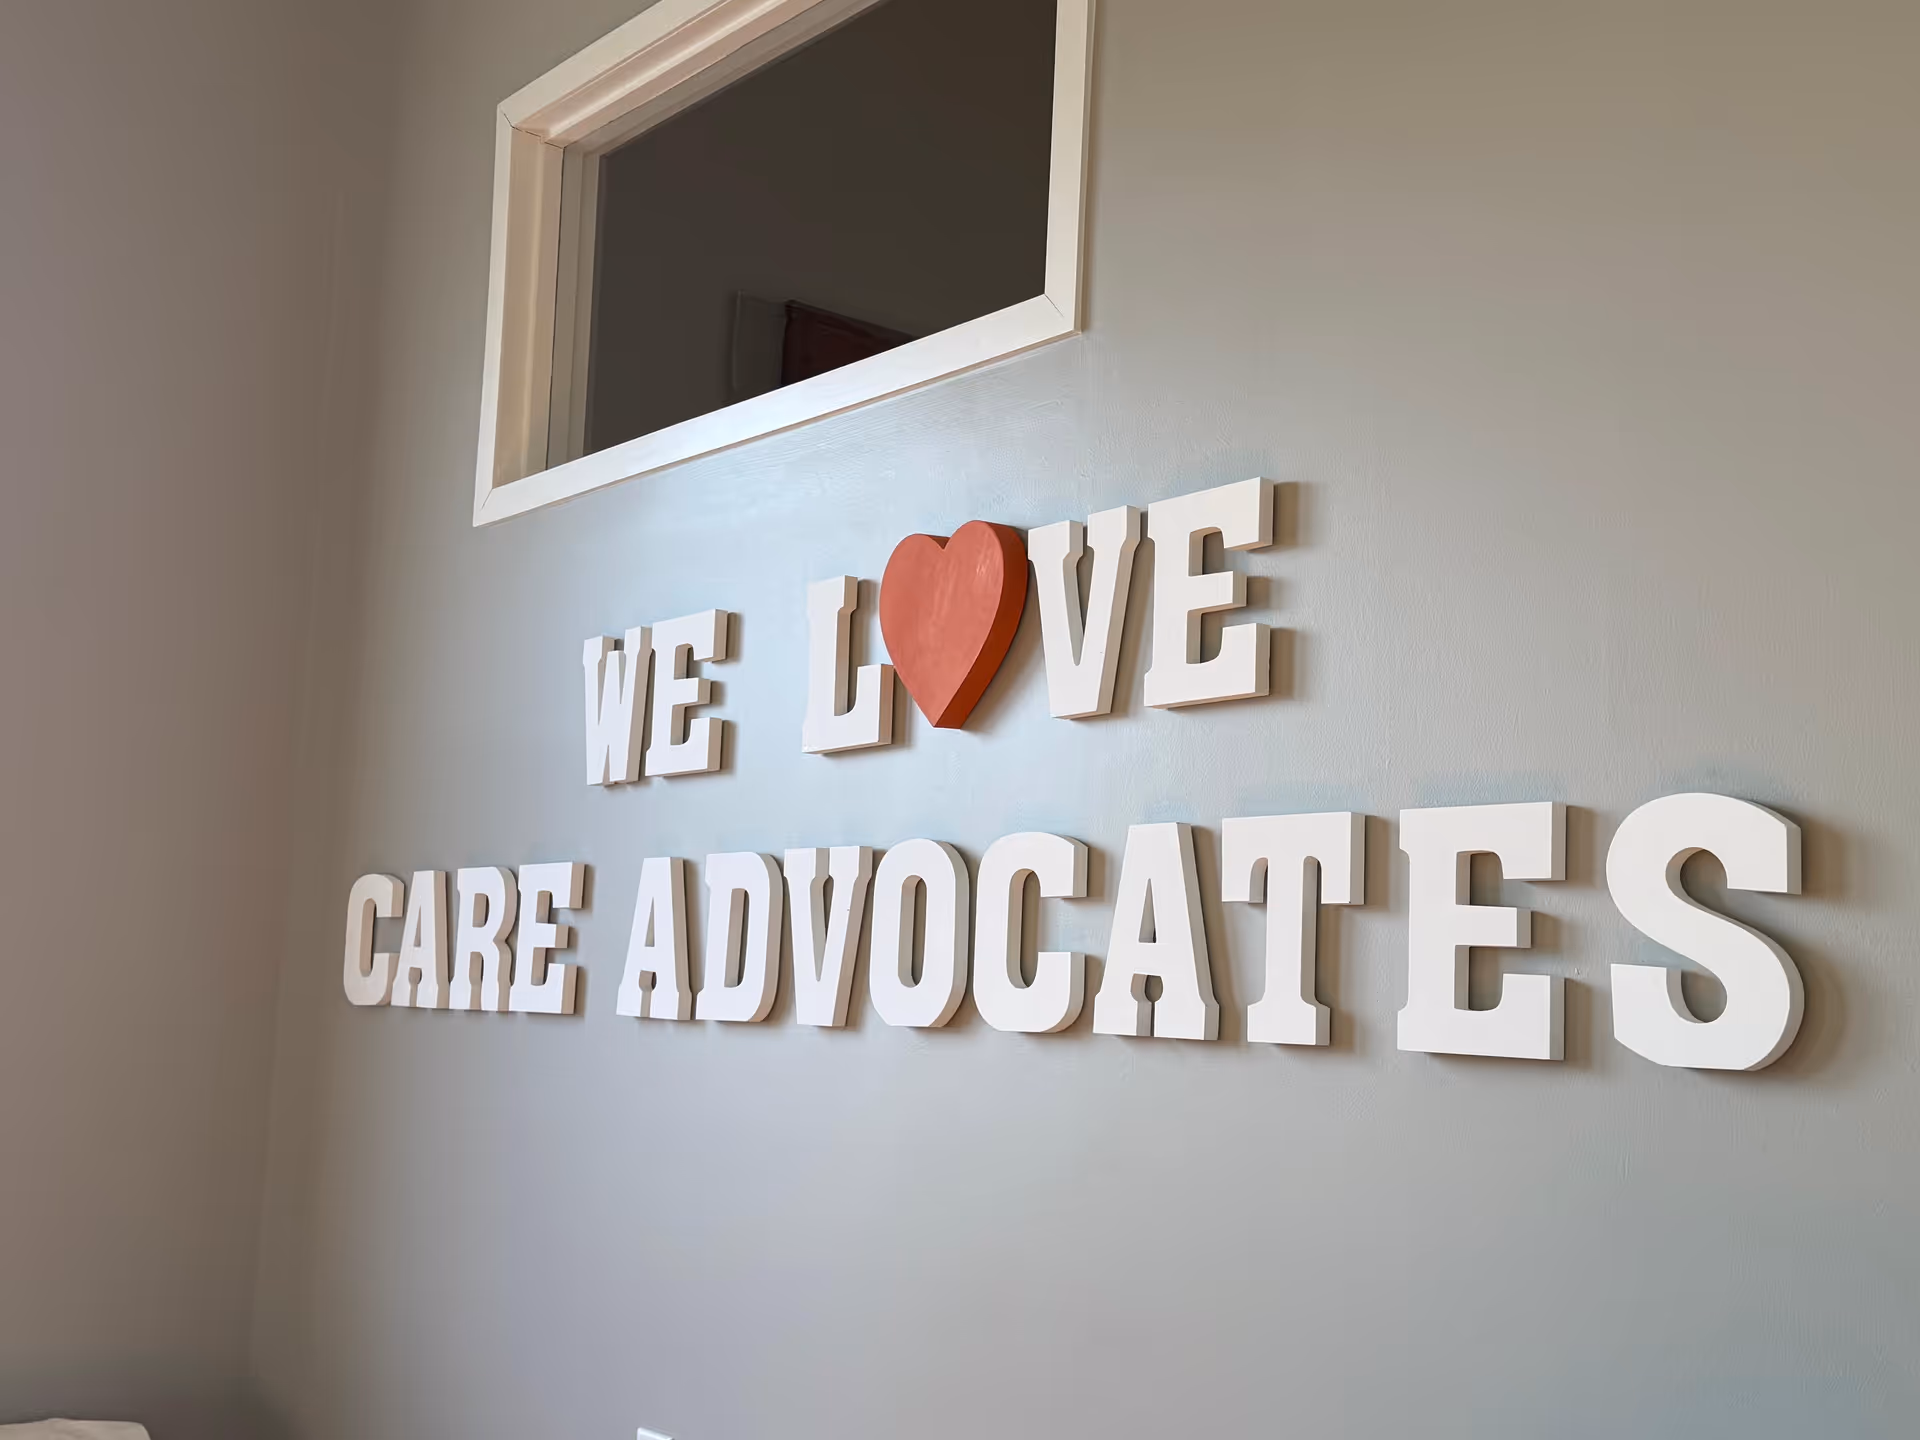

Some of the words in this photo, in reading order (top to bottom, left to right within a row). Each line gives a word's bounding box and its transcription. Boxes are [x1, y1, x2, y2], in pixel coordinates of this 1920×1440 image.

[582, 609, 728, 786] WE
[802, 476, 1274, 754] LVE
[343, 860, 586, 1015] CARE
[615, 792, 1805, 1072] ADVOCATES
